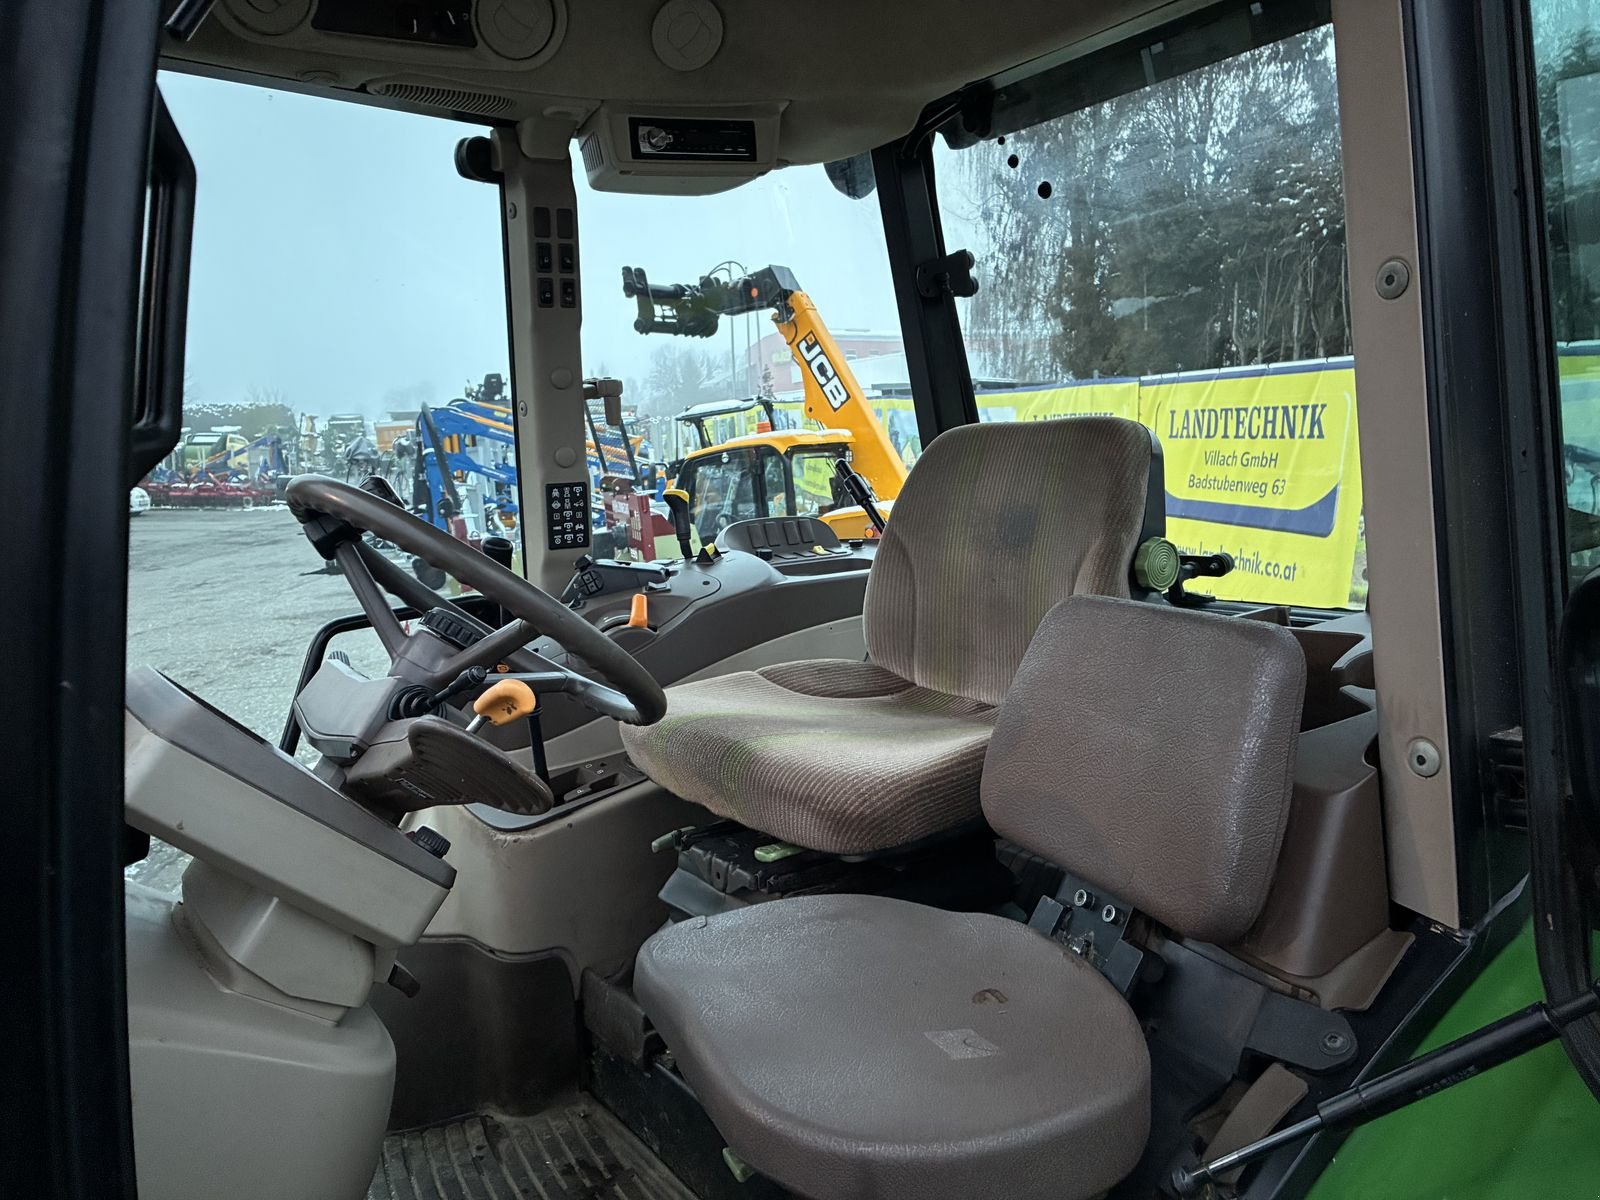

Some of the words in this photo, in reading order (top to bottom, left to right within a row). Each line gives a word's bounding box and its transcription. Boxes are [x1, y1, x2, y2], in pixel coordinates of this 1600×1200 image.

[798, 335, 848, 409] JCB
[1168, 404, 1327, 439] LANDTECHNIK
[1204, 450, 1238, 467] Villach
[1240, 451, 1279, 468] GmbH
[1188, 474, 1268, 498] Badstubenweg
[1271, 479, 1286, 495] 63
